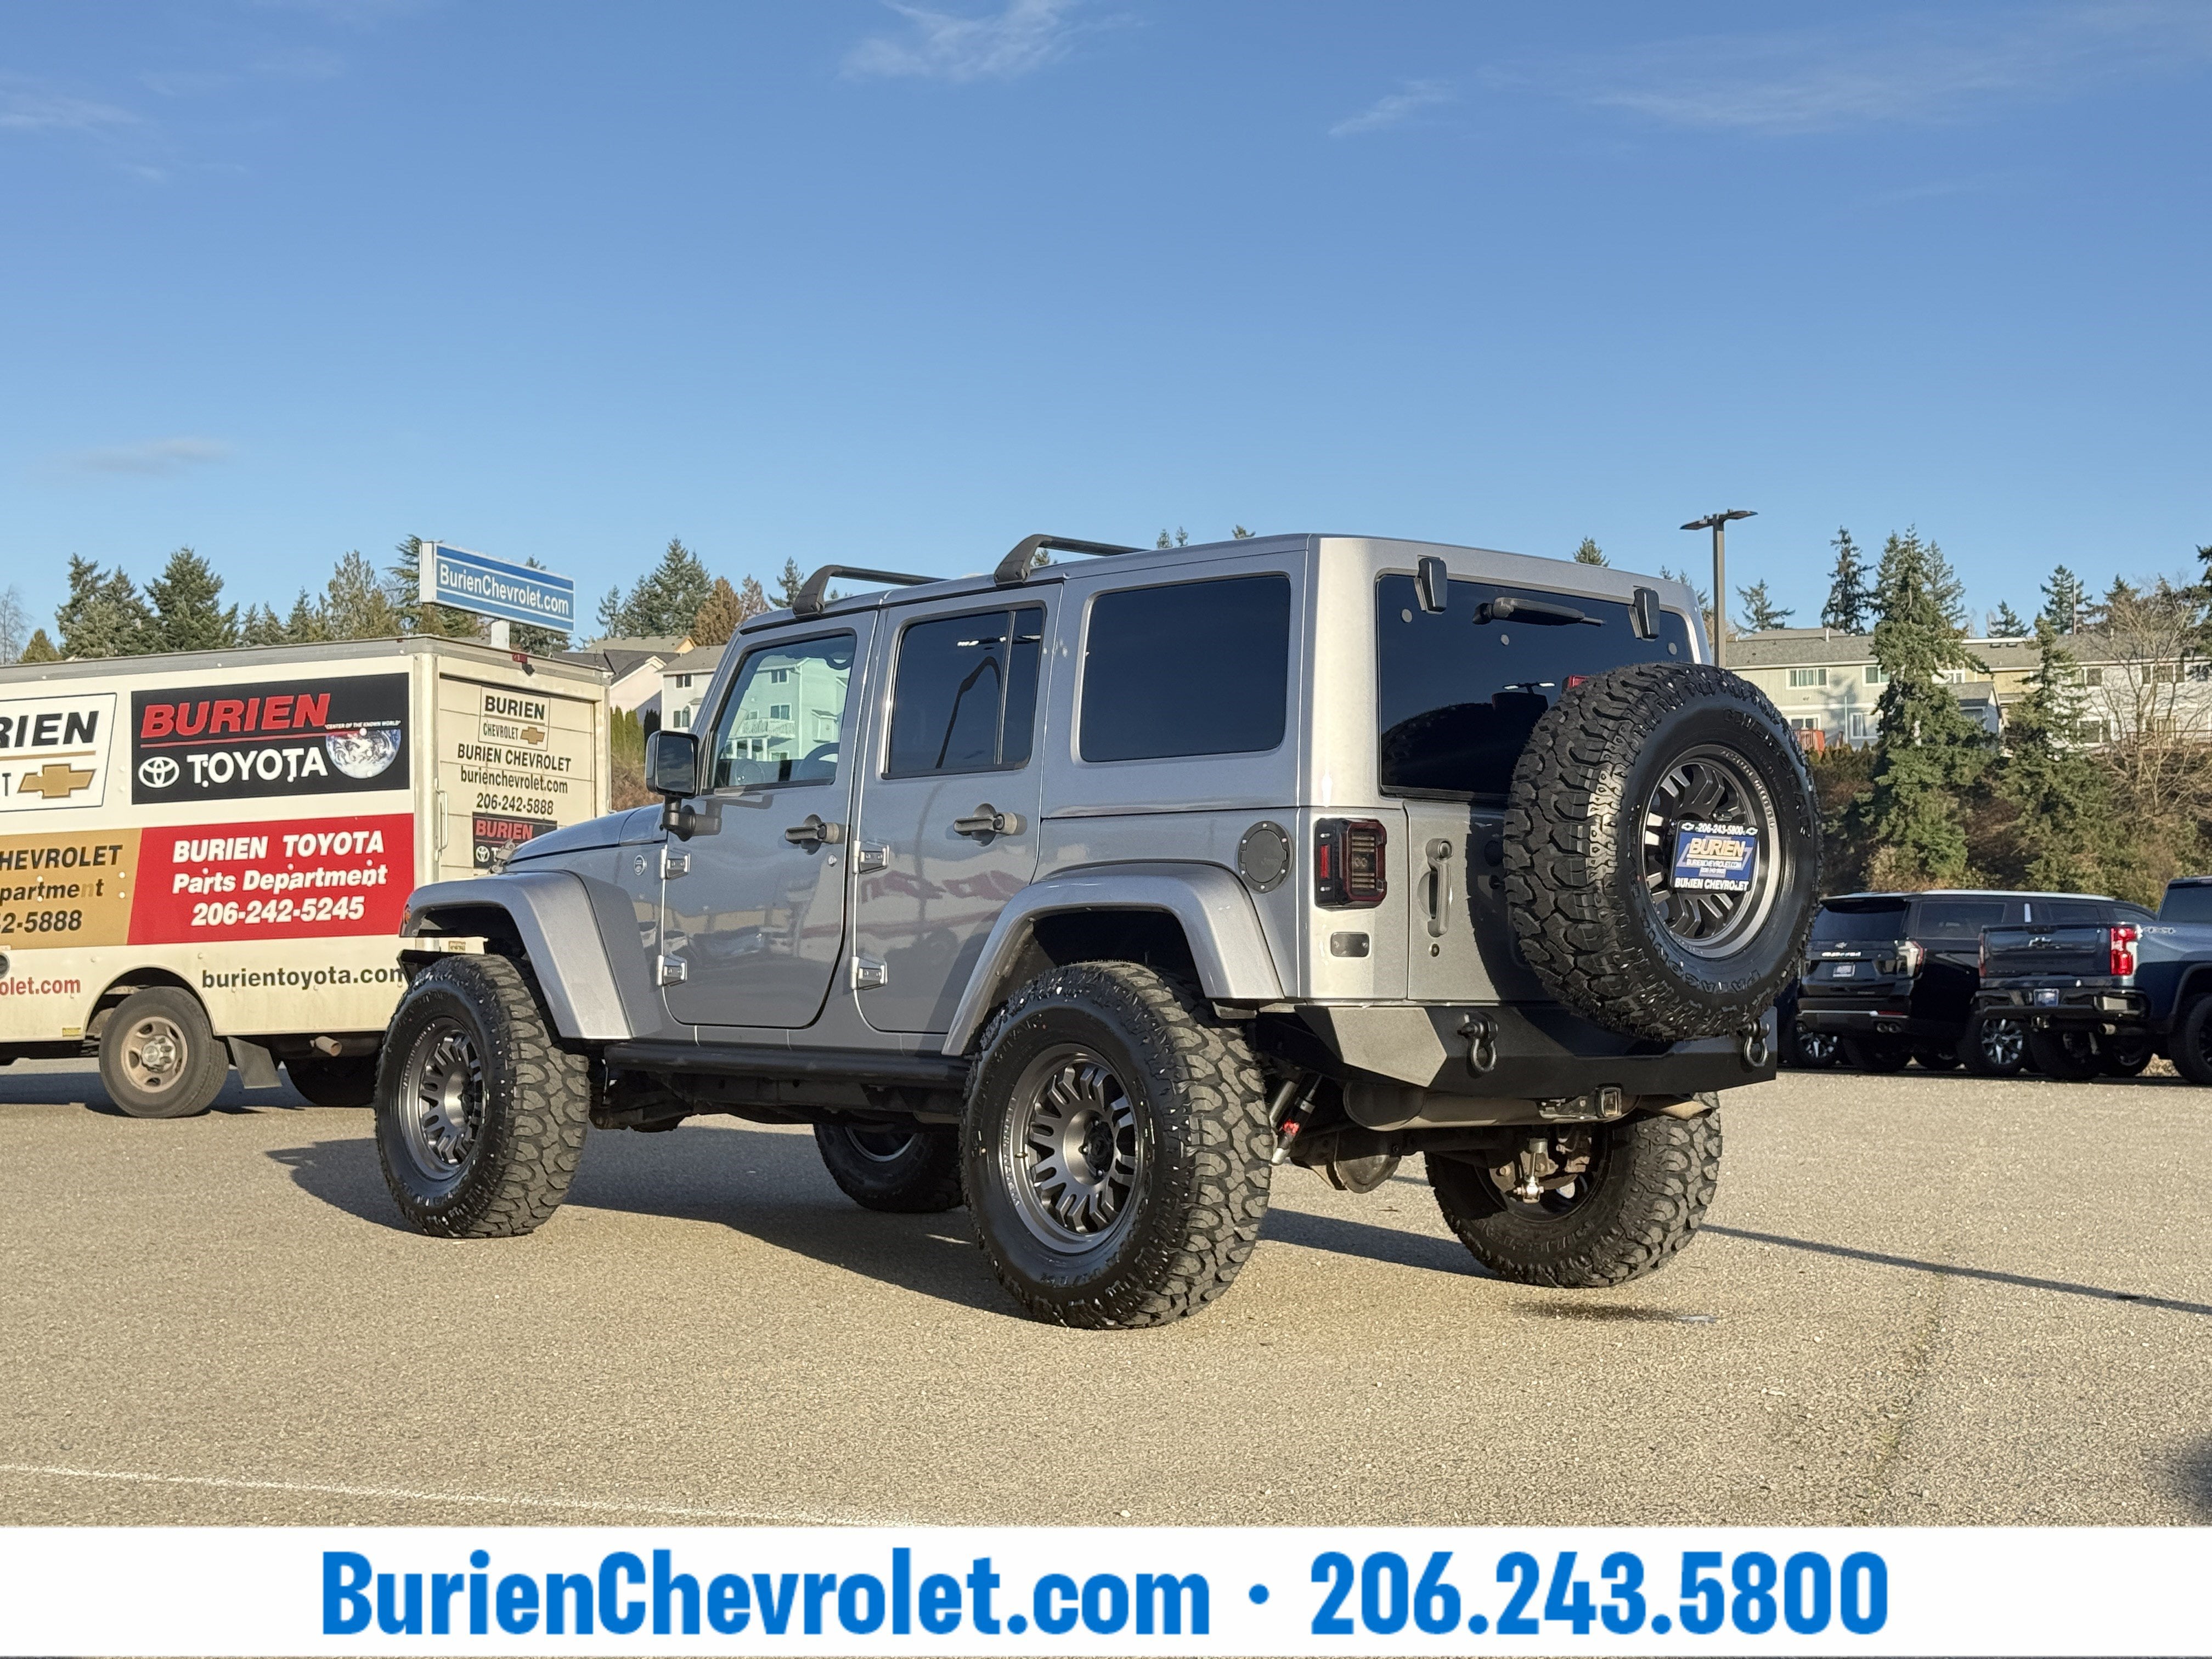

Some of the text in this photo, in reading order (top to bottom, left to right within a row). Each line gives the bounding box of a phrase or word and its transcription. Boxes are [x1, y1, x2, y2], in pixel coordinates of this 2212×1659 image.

[440, 563, 569, 616] BurienChevrolet.com
[140, 693, 331, 738] BURIEN
[485, 696, 545, 720] BURIEN
[483, 722, 518, 740] CHEVROLET
[187, 747, 329, 785] TOYOTA
[458, 743, 571, 772] BURIEN CHEVROLET
[461, 765, 568, 794] burienchevrolet.com
[476, 793, 554, 815] 206-242-5888
[476, 820, 533, 839] BURIEN
[172, 830, 385, 864] BURIEN TOYOTA
[1690, 837, 1746, 857] BURIEN
[172, 864, 388, 894] Parts Department
[1674, 877, 1749, 891] BURIEN CHEVROLET
[0, 910, 82, 933] 2-5888
[191, 896, 365, 927] 206-242-5245
